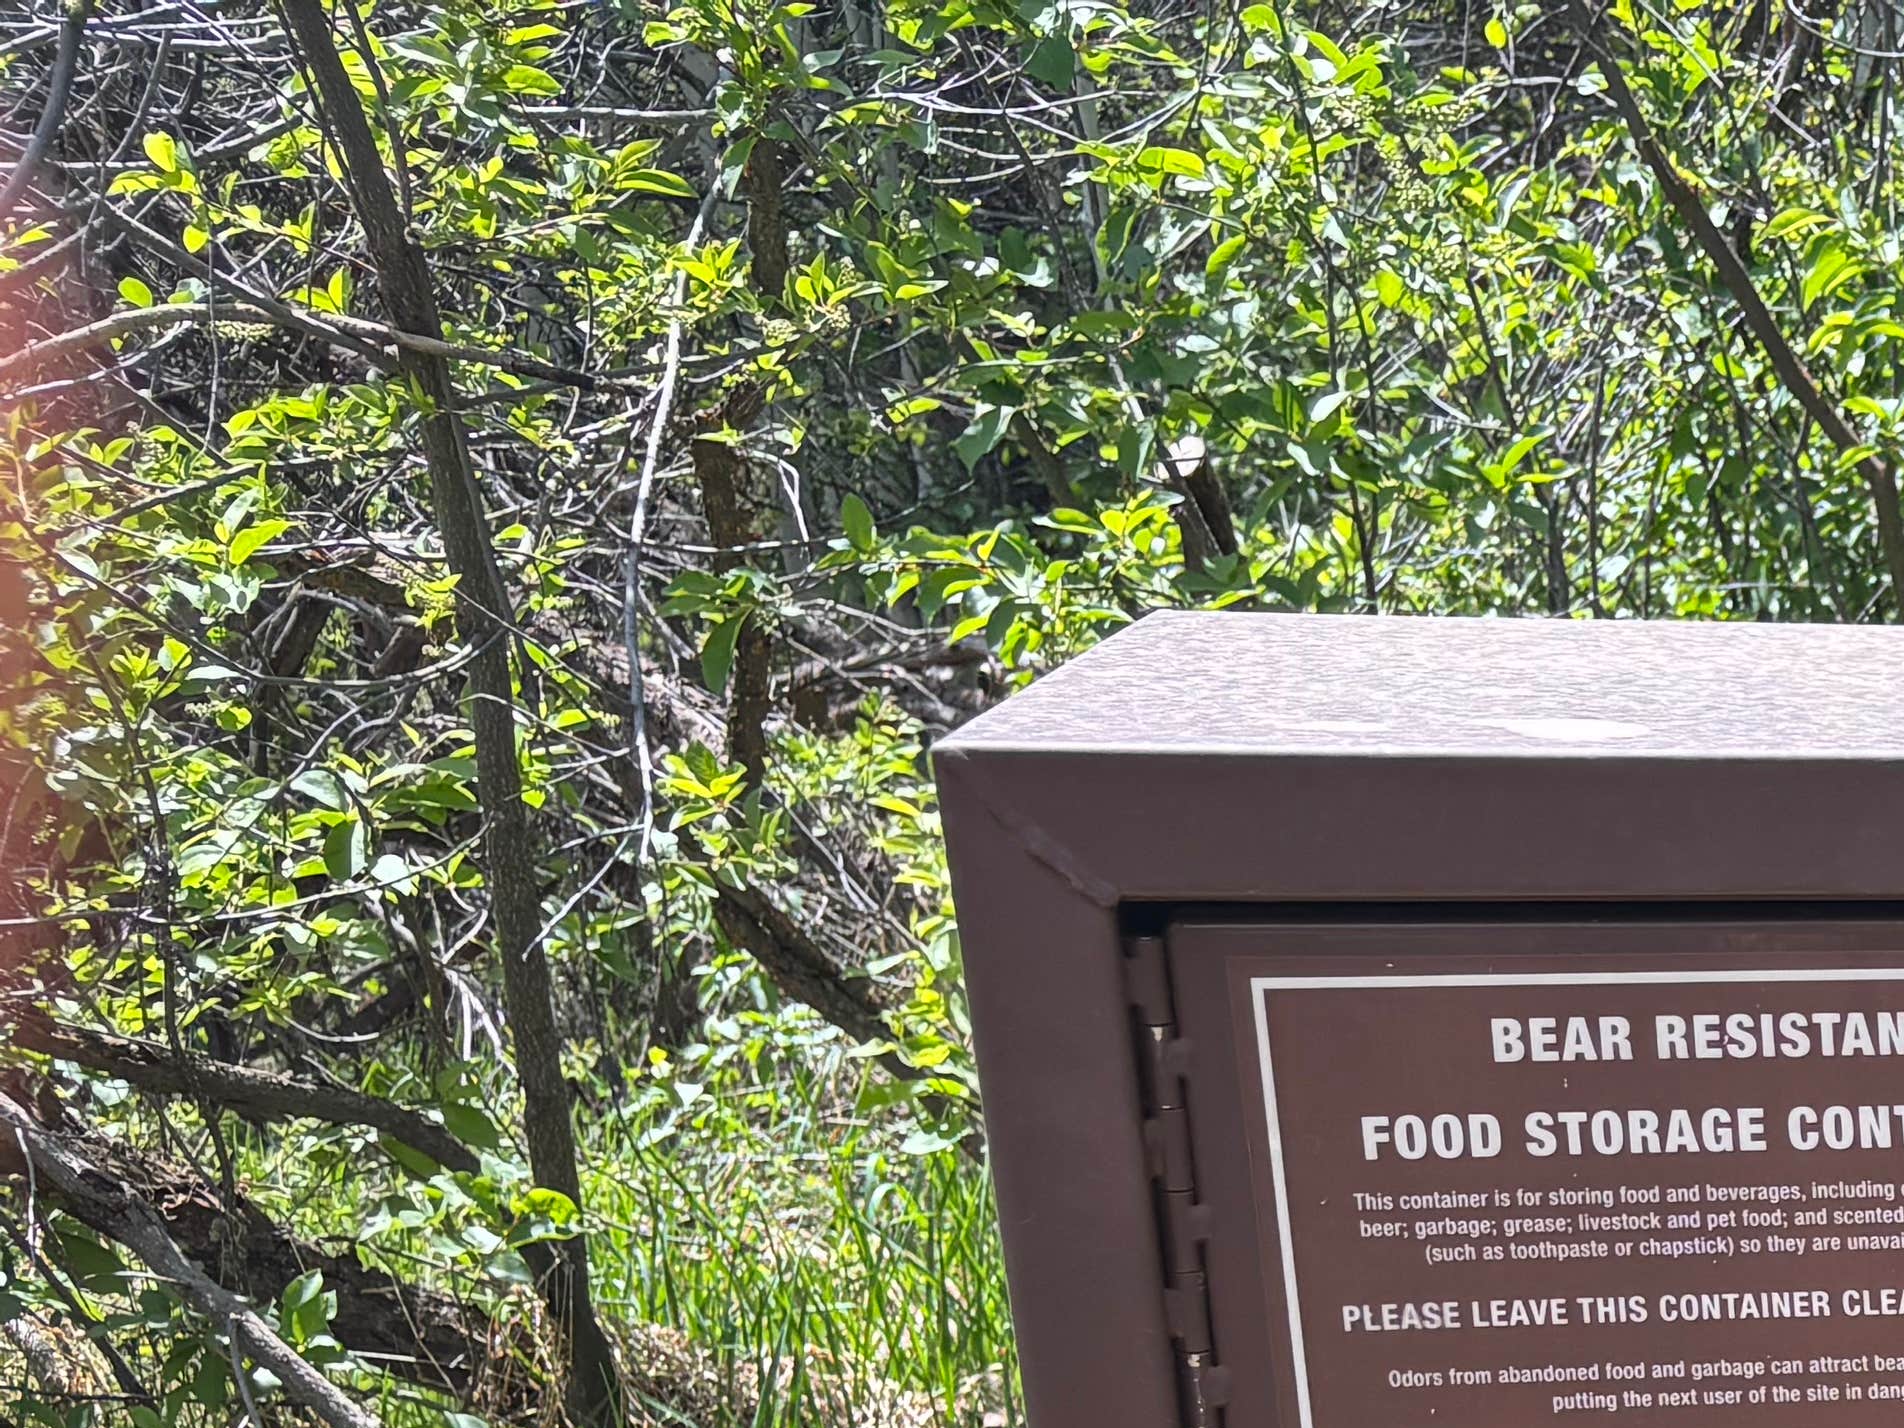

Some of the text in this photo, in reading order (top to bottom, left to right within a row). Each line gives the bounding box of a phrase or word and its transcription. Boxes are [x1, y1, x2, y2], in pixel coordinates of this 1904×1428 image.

[1490, 1015, 1633, 1062] BEAR
[1360, 1113, 1501, 1160] FOOD
[1524, 1107, 1767, 1156] STORAGE
[1352, 1191, 1393, 1211] This
[1399, 1189, 1488, 1209] container
[1493, 1188, 1510, 1207] is
[1515, 1187, 1543, 1206] for
[1548, 1186, 1614, 1208] storing
[1618, 1184, 1660, 1203] food
[1665, 1183, 1700, 1202] and
[1705, 1183, 1806, 1203] beverages,
[1811, 1179, 1895, 1201] including
[1359, 1219, 1408, 1238] beer;
[1414, 1216, 1497, 1239] garbage;
[1502, 1217, 1572, 1237] grease;
[1577, 1211, 1661, 1230] livestock
[1666, 1209, 1700, 1229] and
[1706, 1209, 1737, 1231] pet
[1741, 1207, 1788, 1228] food;
[1793, 1207, 1827, 1225] and
[1832, 1205, 1904, 1224] scented
[1425, 1242, 1476, 1265] (such
[1482, 1245, 1504, 1260] as
[1508, 1239, 1608, 1261] toothpaste
[1614, 1241, 1633, 1256] or
[1638, 1235, 1734, 1258] chapstick)
[1739, 1238, 1761, 1253] so
[1765, 1234, 1806, 1255] they
[1811, 1236, 1841, 1251] are
[1341, 1301, 1461, 1332] PLEASE
[1471, 1297, 1568, 1327] LEAVE
[1575, 1295, 1648, 1323] THIS
[1658, 1290, 1830, 1321] CONTAINER
[1388, 1369, 1443, 1387] Odors
[1448, 1367, 1491, 1385] from
[1498, 1362, 1599, 1383] abandoned
[1604, 1361, 1645, 1380] food
[1651, 1359, 1685, 1378] and
[1690, 1358, 1765, 1380] garbage
[1770, 1359, 1803, 1375] can
[1808, 1354, 1869, 1373] attract
[1552, 1391, 1617, 1413] putting
[1622, 1389, 1652, 1407] the
[1657, 1388, 1698, 1406] next
[1702, 1390, 1743, 1405] user
[1748, 1385, 1766, 1403] of
[1771, 1384, 1800, 1402] the
[1806, 1383, 1839, 1402] site
[1845, 1382, 1862, 1400] in
